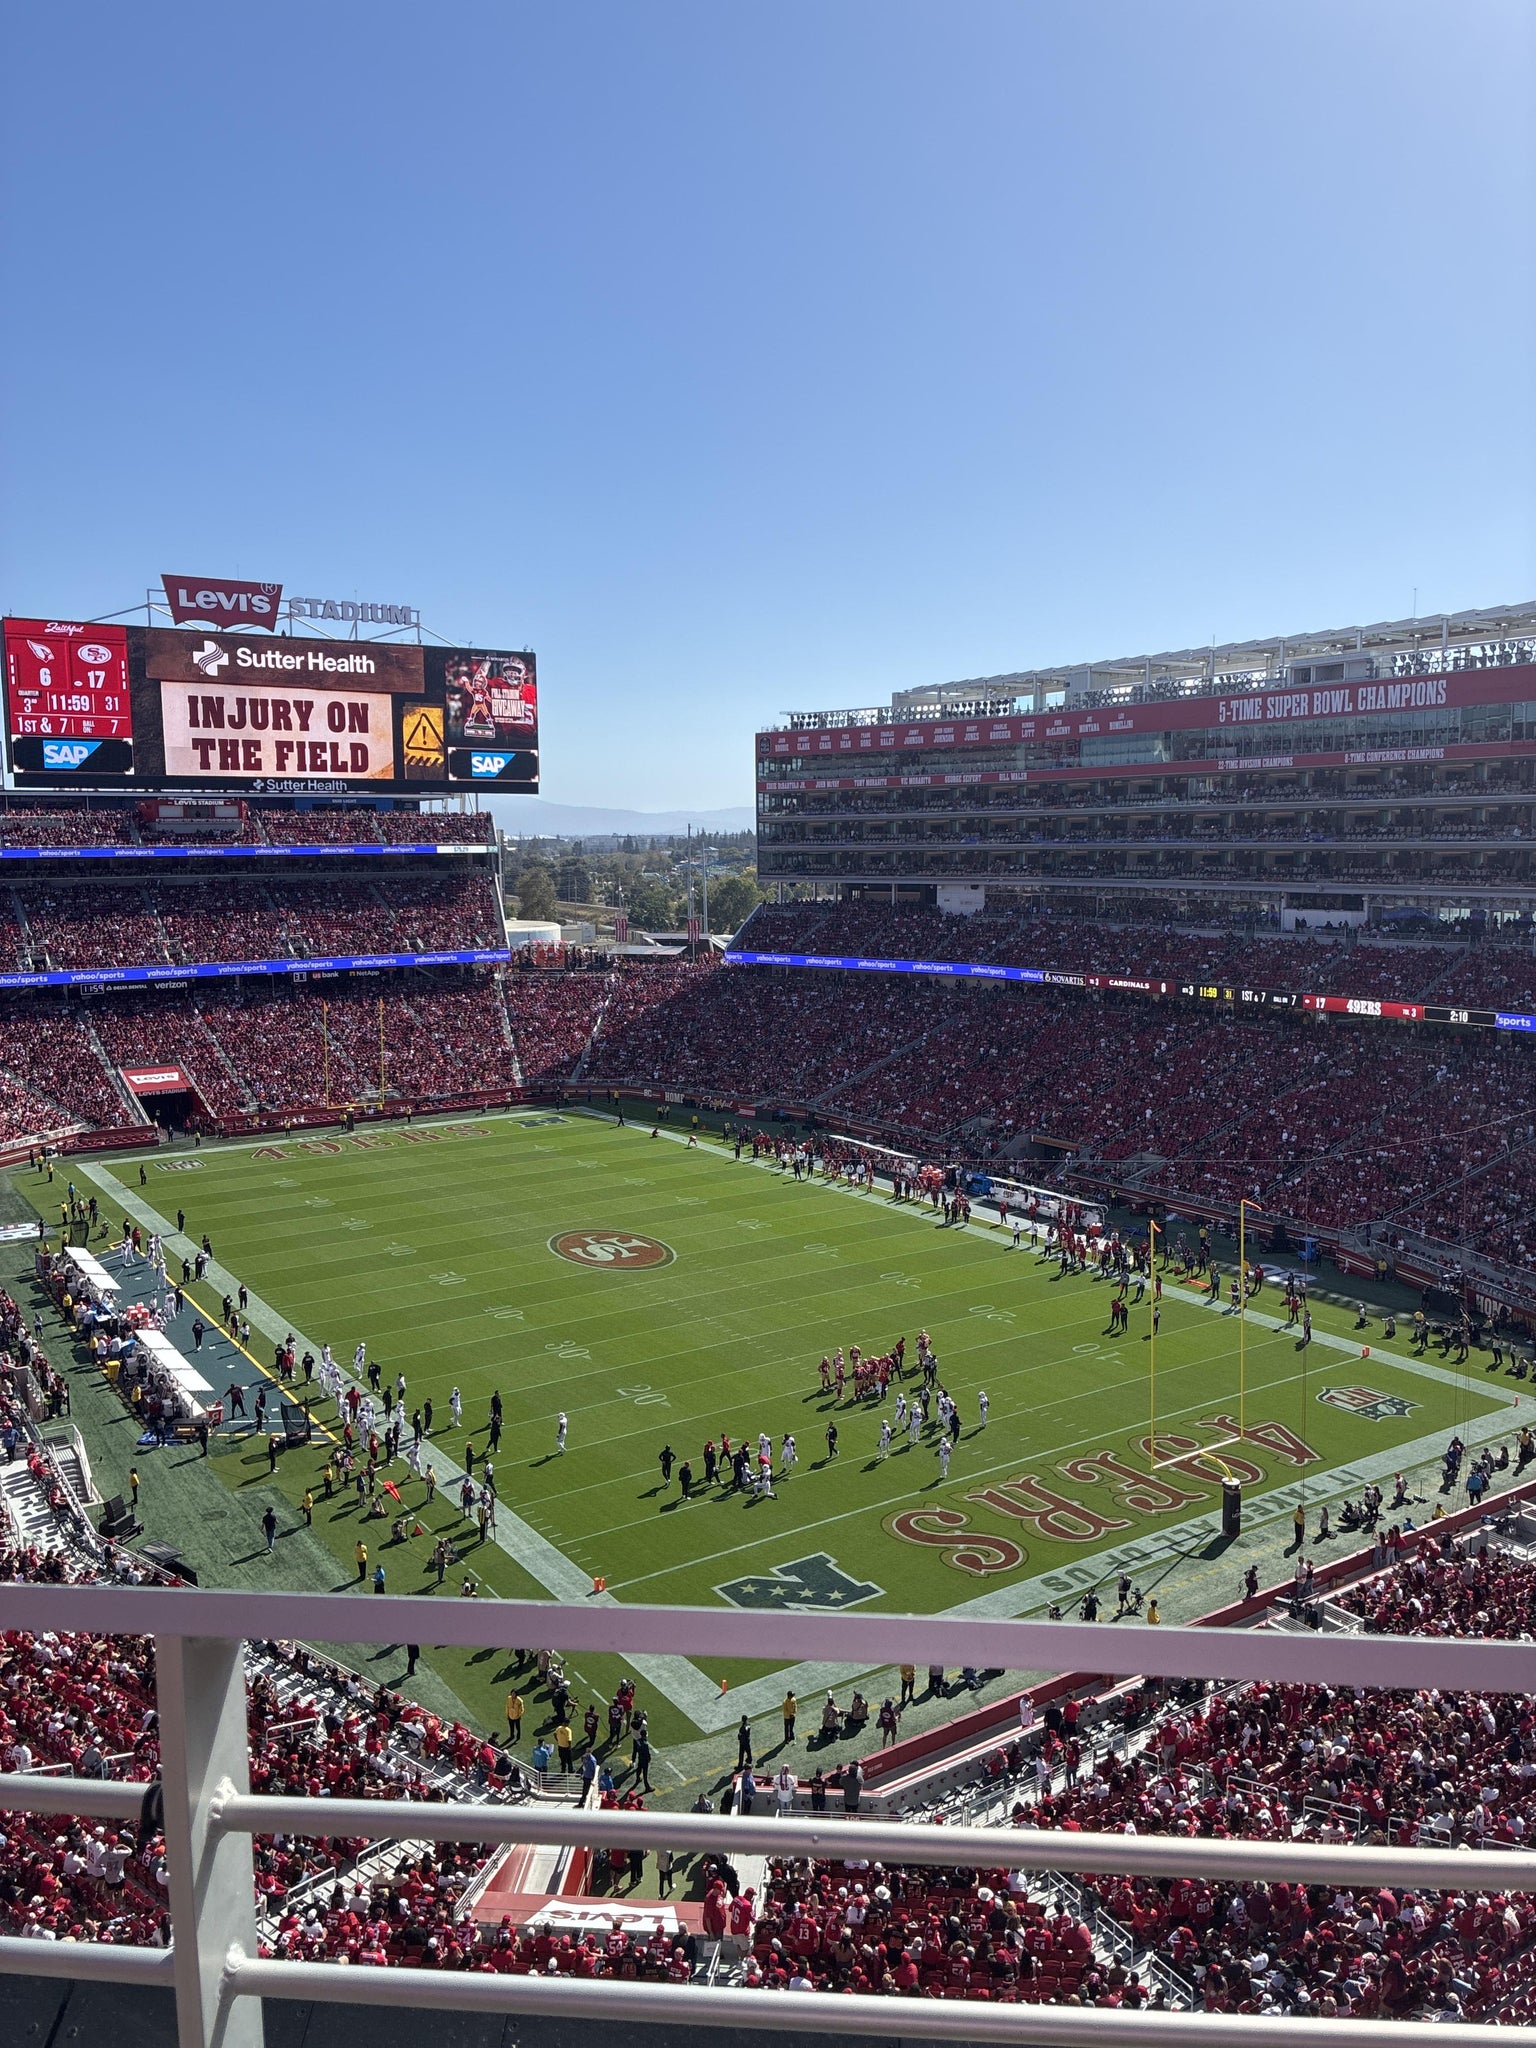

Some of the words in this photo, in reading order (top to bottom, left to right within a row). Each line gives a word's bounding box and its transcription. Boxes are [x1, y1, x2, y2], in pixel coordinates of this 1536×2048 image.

[290, 597, 411, 625] STADIUM
[236, 648, 304, 670] Sutter
[308, 652, 375, 674] Health
[40, 668, 51, 686] 6
[88, 671, 105, 688] 17
[51, 694, 90, 711] 11:59
[105, 696, 119, 711] 31
[1218, 698, 1262, 723] 5-TIME
[1267, 694, 1309, 719] SUPER
[1313, 689, 1352, 714] BOWL
[1357, 680, 1447, 711] CHAMPIONS
[188, 695, 314, 731] INJURY
[327, 701, 369, 733] ON
[18, 717, 37, 732] 1ST
[40, 717, 52, 733] &
[60, 718, 67, 733] 7
[111, 720, 118, 733] 7
[45, 745, 88, 764] SAP
[192, 738, 262, 771] THE
[275, 740, 369, 773] FIELD
[1407, 748, 1444, 760] CHAMPIONS
[471, 756, 505, 773] SAP
[1262, 757, 1293, 768] CHAMPIONS
[266, 779, 306, 790] Sutter
[308, 779, 347, 791] Health
[71, 971, 125, 982] yahoo/sports
[147, 968, 198, 978] yahoo/sports
[218, 964, 267, 973] yahoo/sports
[286, 961, 333, 970] yahoo/sports
[352, 958, 397, 966] yahoo/sports
[414, 955, 457, 964] yahoo/sports
[756, 955, 791, 963] yahoo/sports
[805, 958, 842, 966] yahoo/sports
[858, 961, 896, 969] yahoo/sports
[912, 963, 953, 972] yahoo/sports
[971, 967, 1006, 976] yahoo/sports
[154, 981, 187, 989] verizon
[1052, 976, 1084, 985] NOVARTIS
[1108, 979, 1150, 989] CARDINALS
[1189, 986, 1194, 995] 3
[1200, 986, 1217, 998] 11:59
[1242, 990, 1253, 1001] 1ST
[1261, 992, 1266, 1003] 7
[1292, 995, 1296, 1006] 7
[1316, 997, 1326, 1009] 17
[1346, 1000, 1381, 1016] 49ERS
[1412, 1008, 1416, 1017] 3
[1450, 1011, 1468, 1022] 2:10
[250, 1122, 494, 1161] 49ERS
[429, 1271, 467, 1285] 50
[544, 1340, 589, 1359] 30
[1072, 1342, 1122, 1362] 10
[616, 1384, 667, 1405] 20
[1336, 1471, 1365, 1486] IT
[888, 1413, 1326, 1576] 49ERS
[1239, 1484, 1329, 1526] TAKES
[1104, 1547, 1152, 1570] OF
[1041, 1567, 1100, 1593] US
[731, 1905, 741, 1924] 16
[799, 1928, 810, 1940] 13
[609, 1942, 623, 1954] 54
[1033, 1942, 1046, 1951] 54
